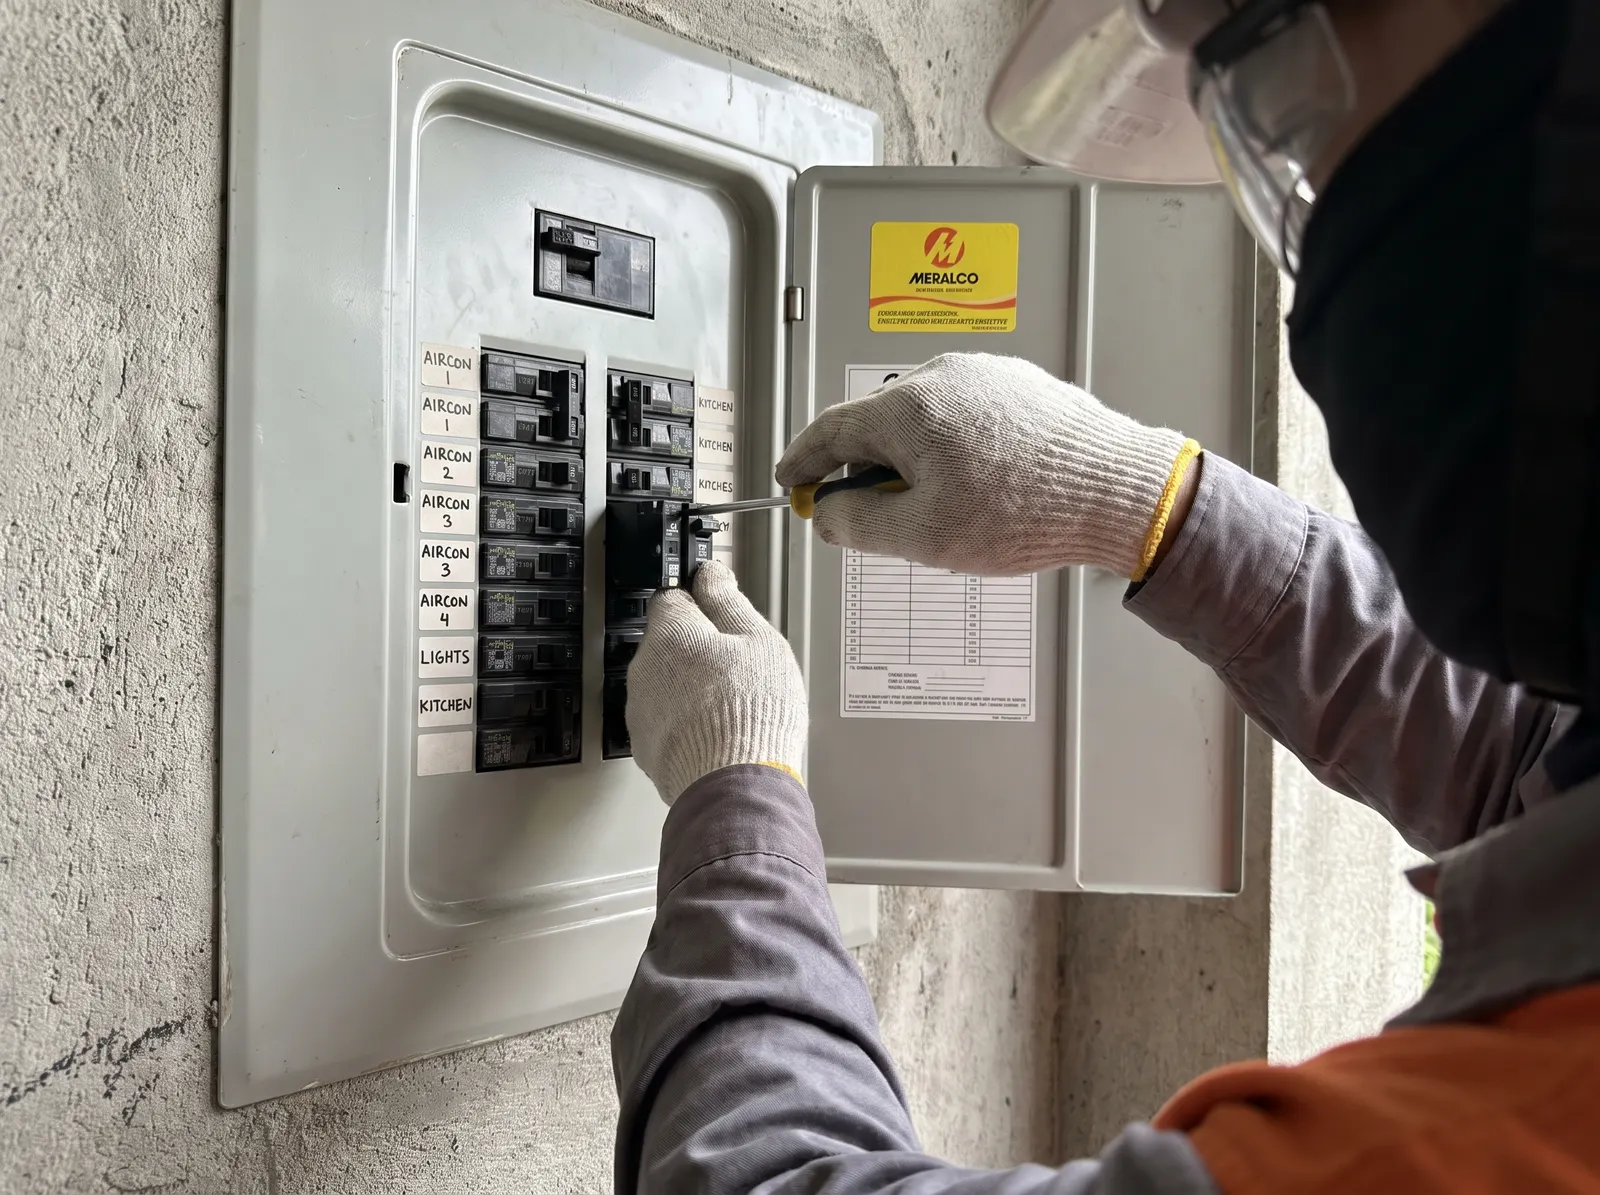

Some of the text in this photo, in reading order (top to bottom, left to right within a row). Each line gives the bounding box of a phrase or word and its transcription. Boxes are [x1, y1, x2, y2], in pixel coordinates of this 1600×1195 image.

[908, 272, 979, 285] MERALCO
[423, 350, 472, 371] AIRCON
[446, 370, 450, 385] 1
[422, 397, 472, 416] AIRCON
[698, 397, 733, 413] KITCHEN
[445, 418, 449, 432] 1
[698, 436, 733, 453] KITCHEN
[423, 445, 472, 463] AIRCON
[443, 466, 454, 480] 2
[422, 494, 470, 510] AIRCON
[442, 514, 452, 528] 3
[421, 544, 470, 560] AIRCON
[441, 563, 451, 577] 3
[420, 593, 468, 608] AIRCON
[440, 613, 449, 627] 4
[420, 649, 470, 665] LIGHTS
[420, 697, 472, 714] KITCHEN
